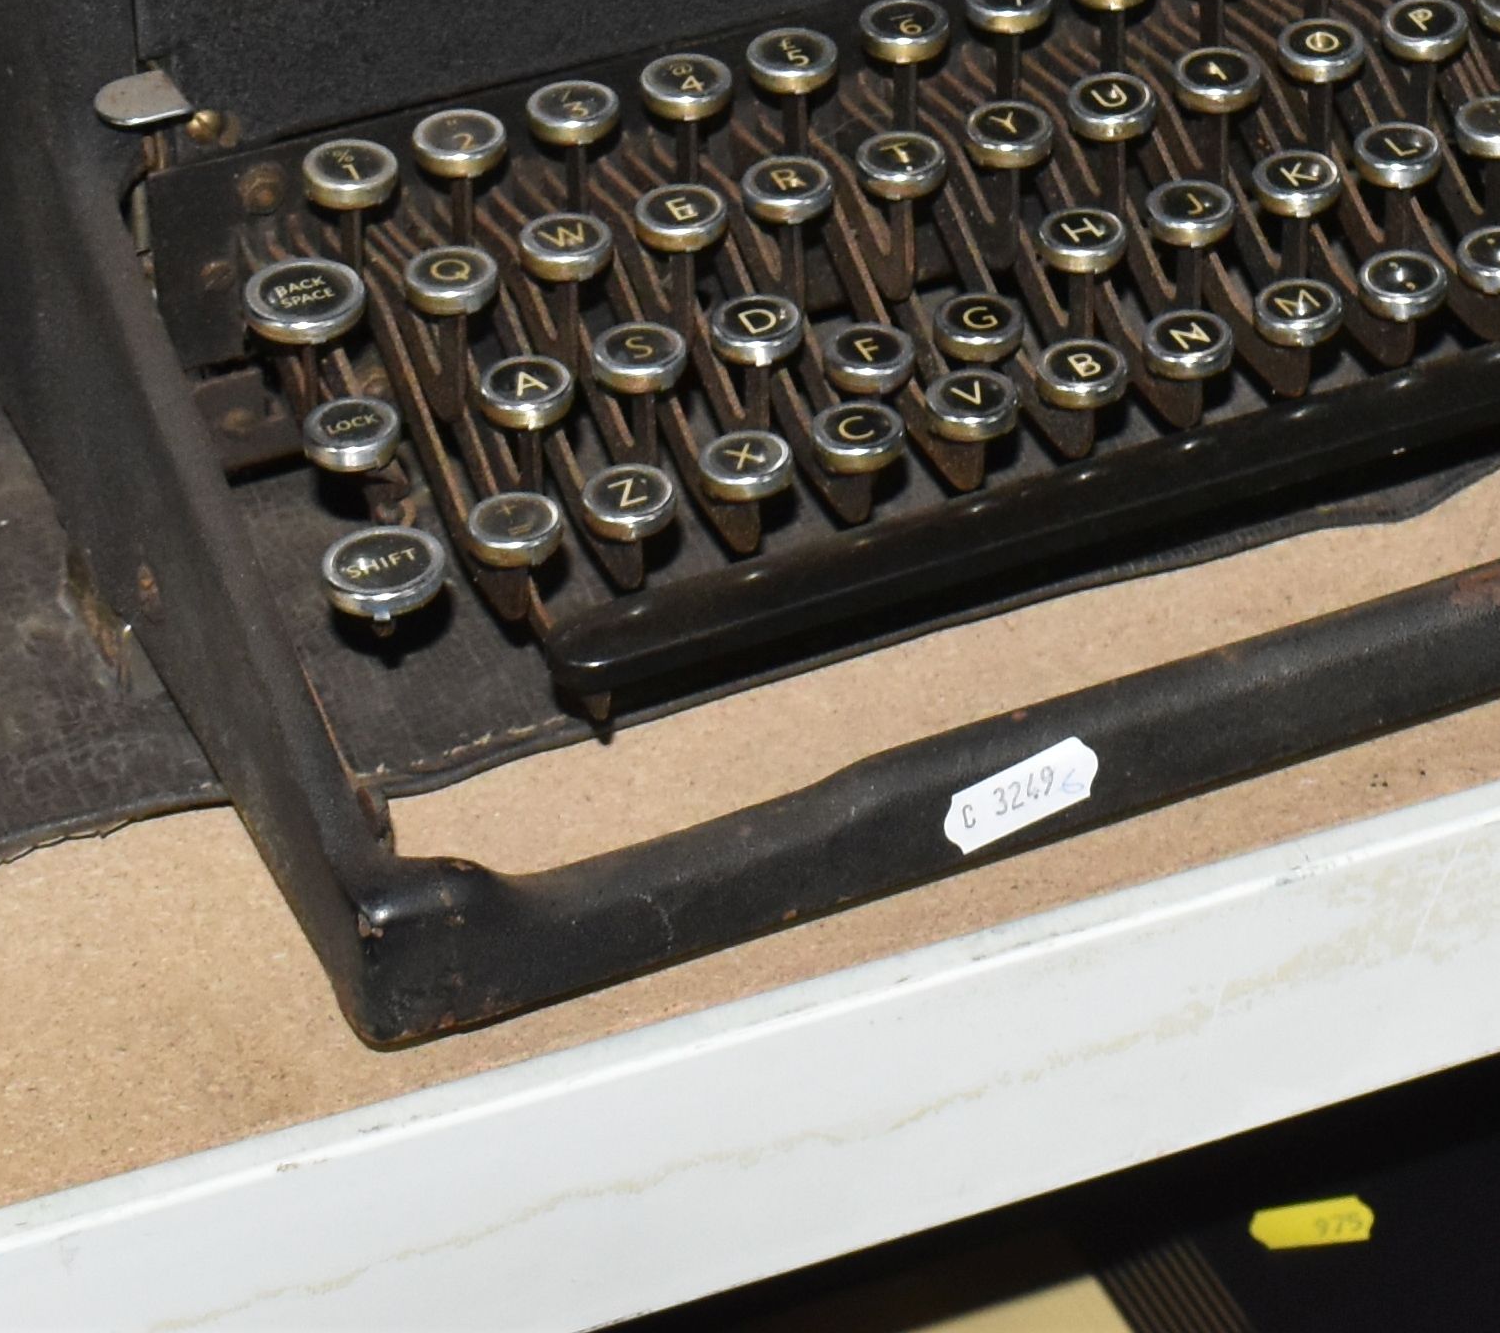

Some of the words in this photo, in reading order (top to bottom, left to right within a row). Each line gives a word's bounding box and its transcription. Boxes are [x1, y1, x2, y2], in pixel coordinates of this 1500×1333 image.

[680, 75, 706, 93] 4
[786, 48, 811, 67] 5
[429, 258, 472, 282] Q
[537, 222, 586, 249] W
[665, 196, 700, 222] E
[770, 168, 807, 192] R
[878, 141, 912, 165] T
[988, 111, 1018, 134] Y
[1090, 83, 1129, 109] U
[1304, 30, 1341, 54] O
[1407, 7, 1434, 32] P
[515, 370, 549, 397] A
[624, 336, 653, 360] S
[737, 307, 777, 334] D
[853, 336, 881, 363] F
[961, 305, 999, 330] G
[1060, 216, 1106, 244] H
[1186, 192, 1206, 216] J
[1279, 161, 1319, 188] K
[1383, 136, 1420, 158] L
[273, 274, 328, 300] BACK
[279, 286, 336, 310] SPACE
[607, 476, 649, 508] Z
[723, 441, 766, 471] X
[837, 415, 874, 441] C
[950, 379, 983, 406] V
[1067, 351, 1102, 378] B
[1169, 321, 1211, 350] N
[1273, 287, 1322, 318] M
[326, 412, 380, 435] LOCK
[348, 546, 417, 579] SHIFT
[961, 804, 977, 829] C
